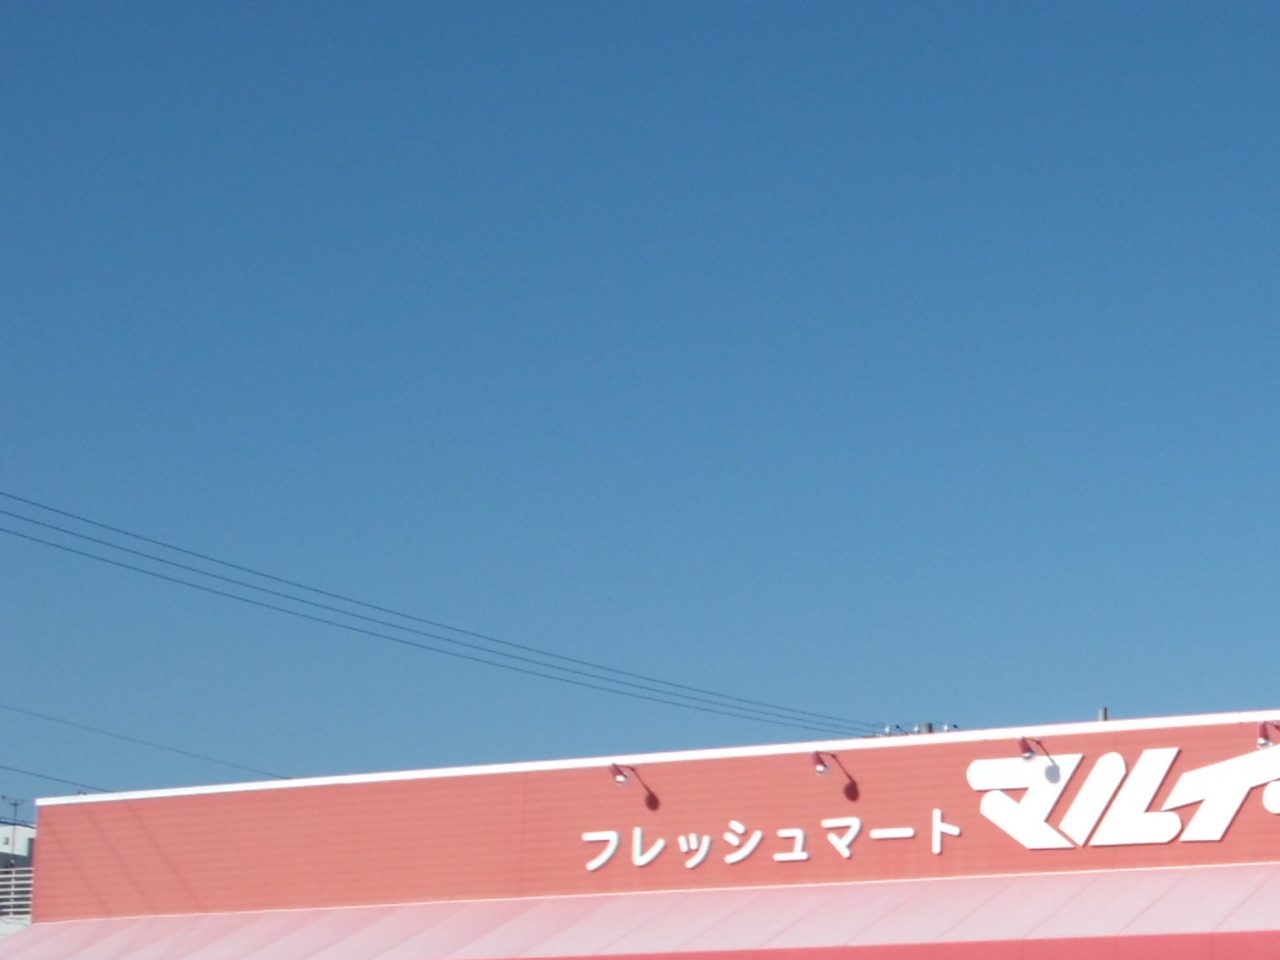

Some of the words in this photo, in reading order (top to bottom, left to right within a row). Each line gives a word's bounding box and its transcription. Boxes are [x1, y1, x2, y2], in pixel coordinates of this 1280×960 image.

[581, 808, 961, 871] フレッシュマート
